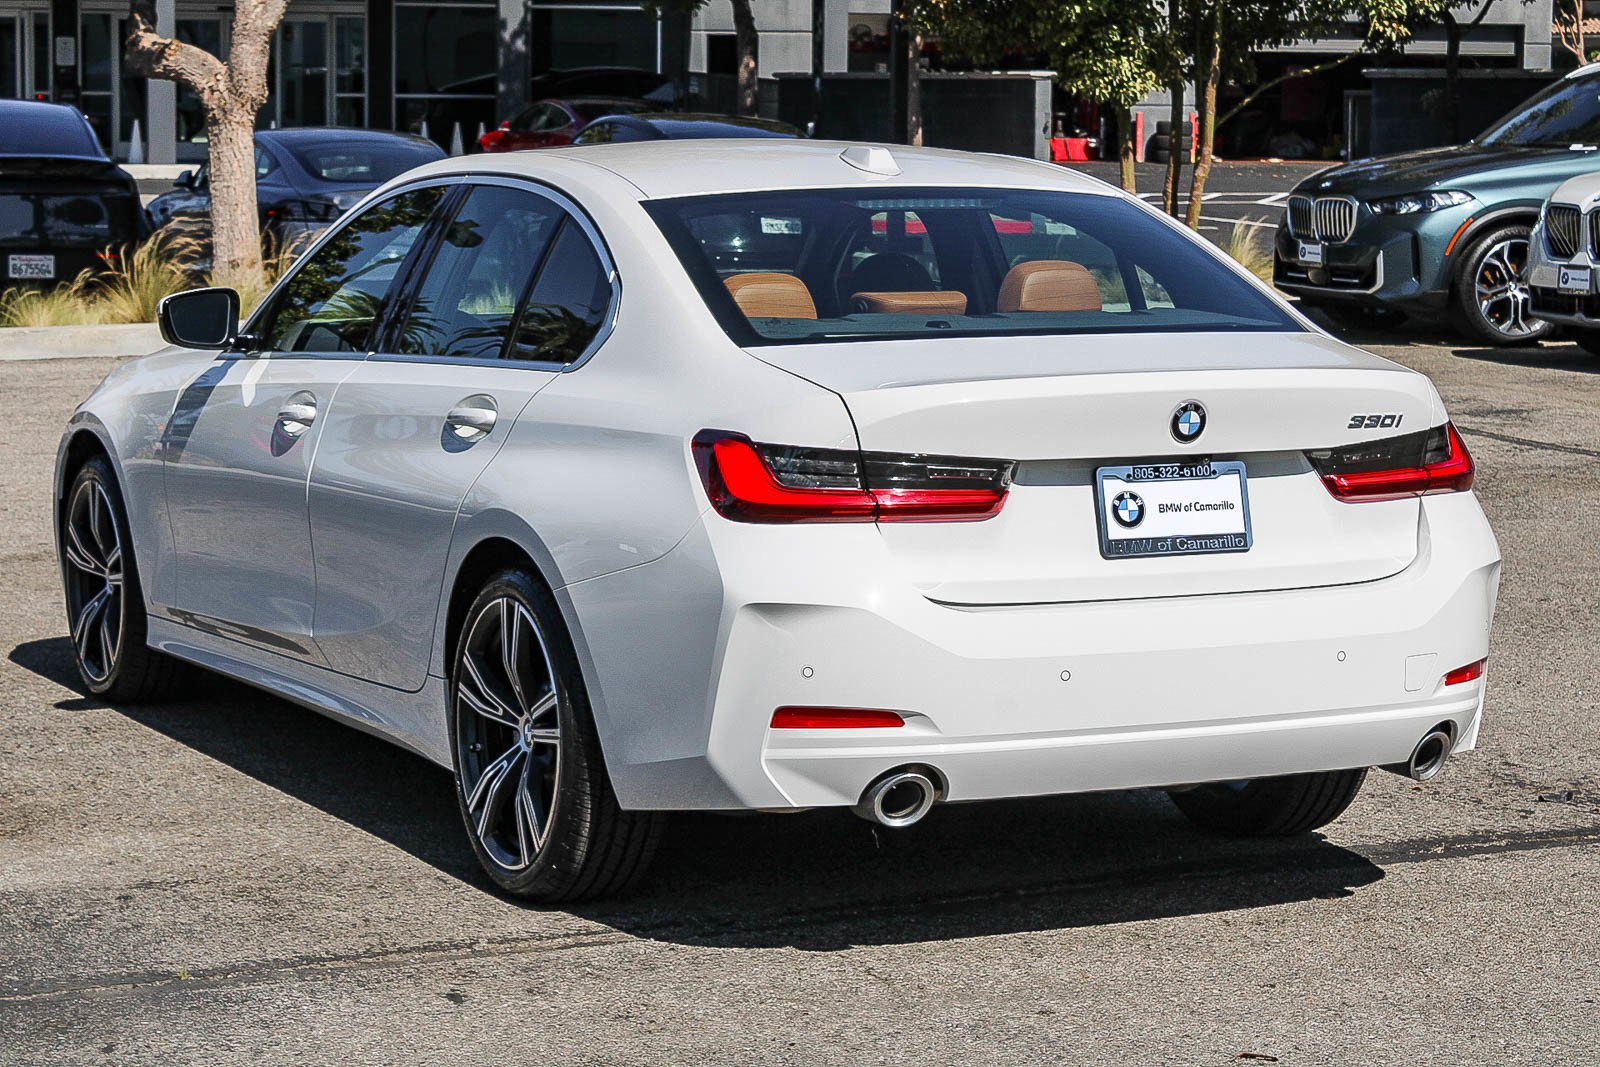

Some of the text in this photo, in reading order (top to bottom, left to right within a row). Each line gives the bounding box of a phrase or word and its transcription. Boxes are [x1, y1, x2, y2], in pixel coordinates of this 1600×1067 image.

[1347, 414, 1403, 429] 330i
[1134, 465, 1210, 479] 805-322-6100
[1158, 500, 1235, 513] BMW of Camarillo
[1157, 538, 1173, 550] of
[1176, 535, 1244, 550] Camarillo
